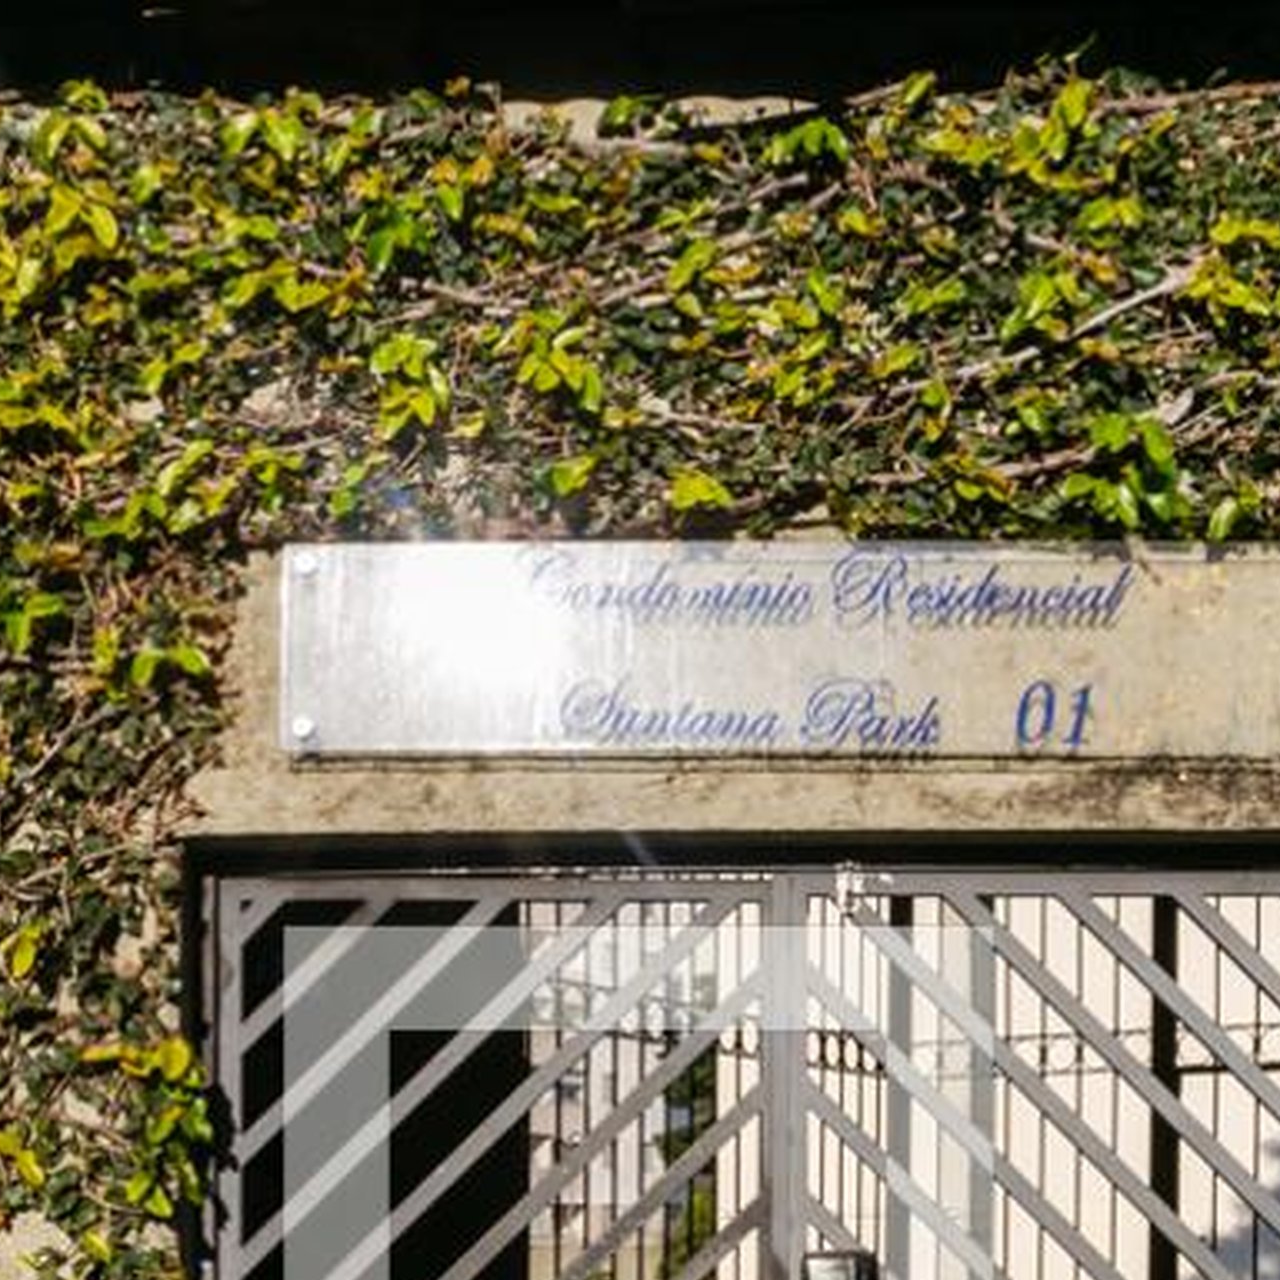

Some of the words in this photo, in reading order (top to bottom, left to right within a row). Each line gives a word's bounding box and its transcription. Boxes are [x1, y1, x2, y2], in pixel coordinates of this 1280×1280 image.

[830, 551, 1133, 613] Residencial
[559, 673, 783, 741] Santana
[800, 678, 940, 746] Park
[1016, 680, 1093, 746] 01
